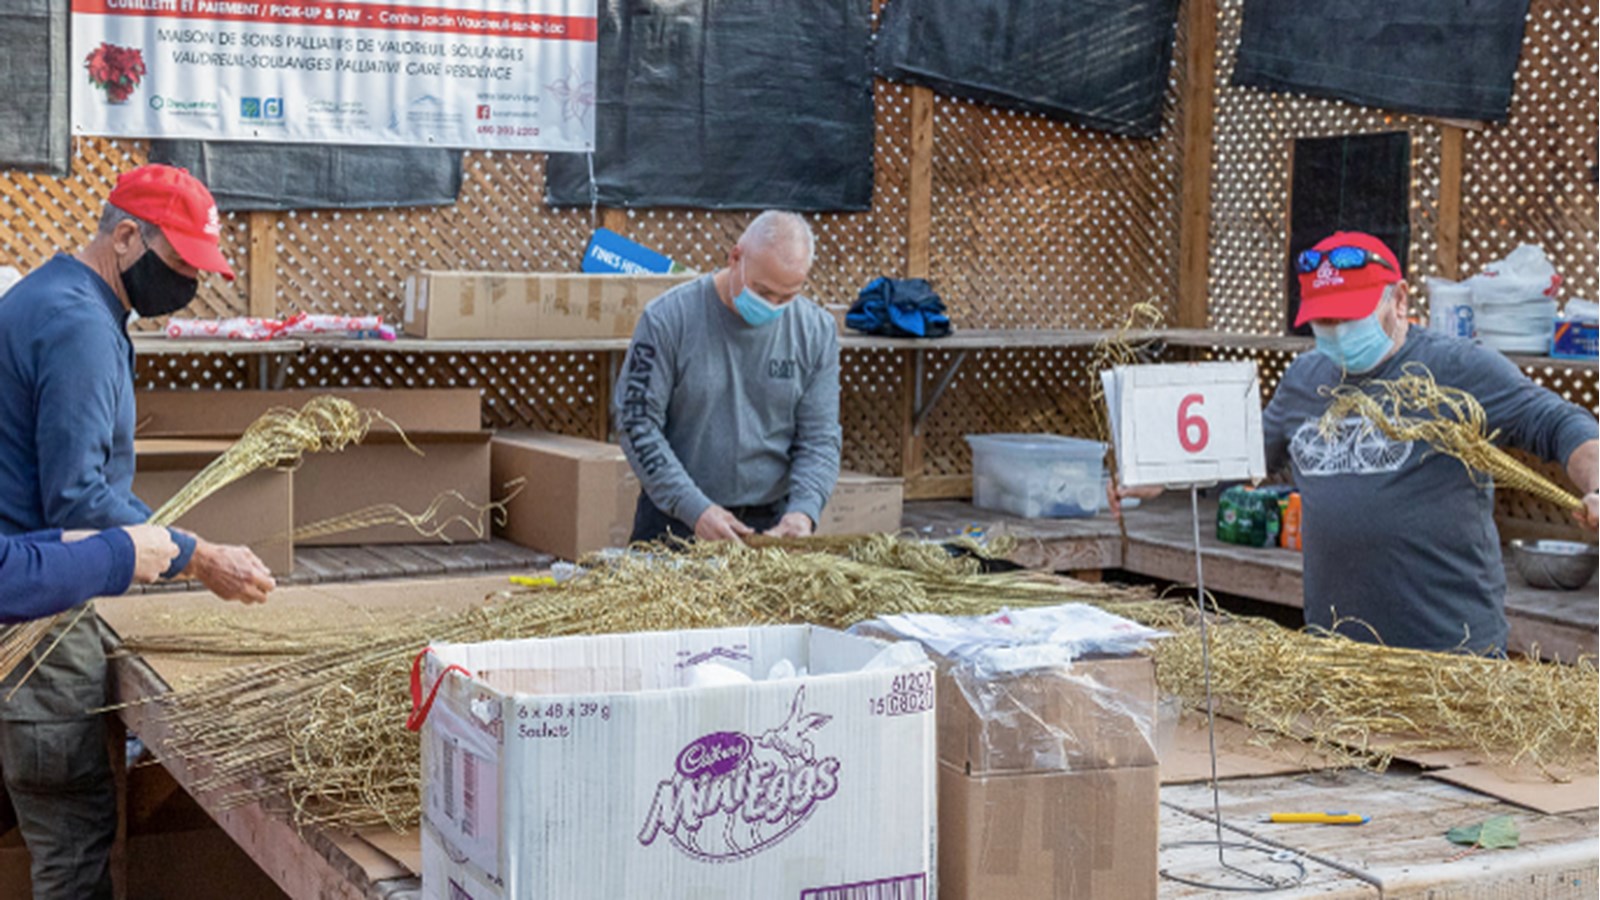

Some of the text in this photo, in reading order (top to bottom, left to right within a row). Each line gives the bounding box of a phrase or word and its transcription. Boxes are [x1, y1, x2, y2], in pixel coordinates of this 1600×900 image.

[181, 0, 195, 12] ET
[198, 1, 259, 15] PAIEMENT
[270, 5, 321, 19] PICK-UP
[324, 9, 334, 20] &
[338, 9, 362, 21] PAY
[379, 11, 419, 24] Centre
[157, 29, 215, 43] MAISON
[219, 32, 237, 45] DE
[241, 33, 283, 47] SOINS
[286, 36, 354, 51] PALLIATIFS
[357, 39, 373, 52] DE
[172, 51, 513, 80] VAUDREUIL-SOULANGES PALLIATIVE CARE RESIDENCE
[591, 244, 621, 270] FINES
[768, 359, 797, 379] CAT
[1176, 393, 1210, 454] 6
[517, 702, 611, 721] 6 x 48 x 39 g
[680, 742, 743, 775] Cadbury
